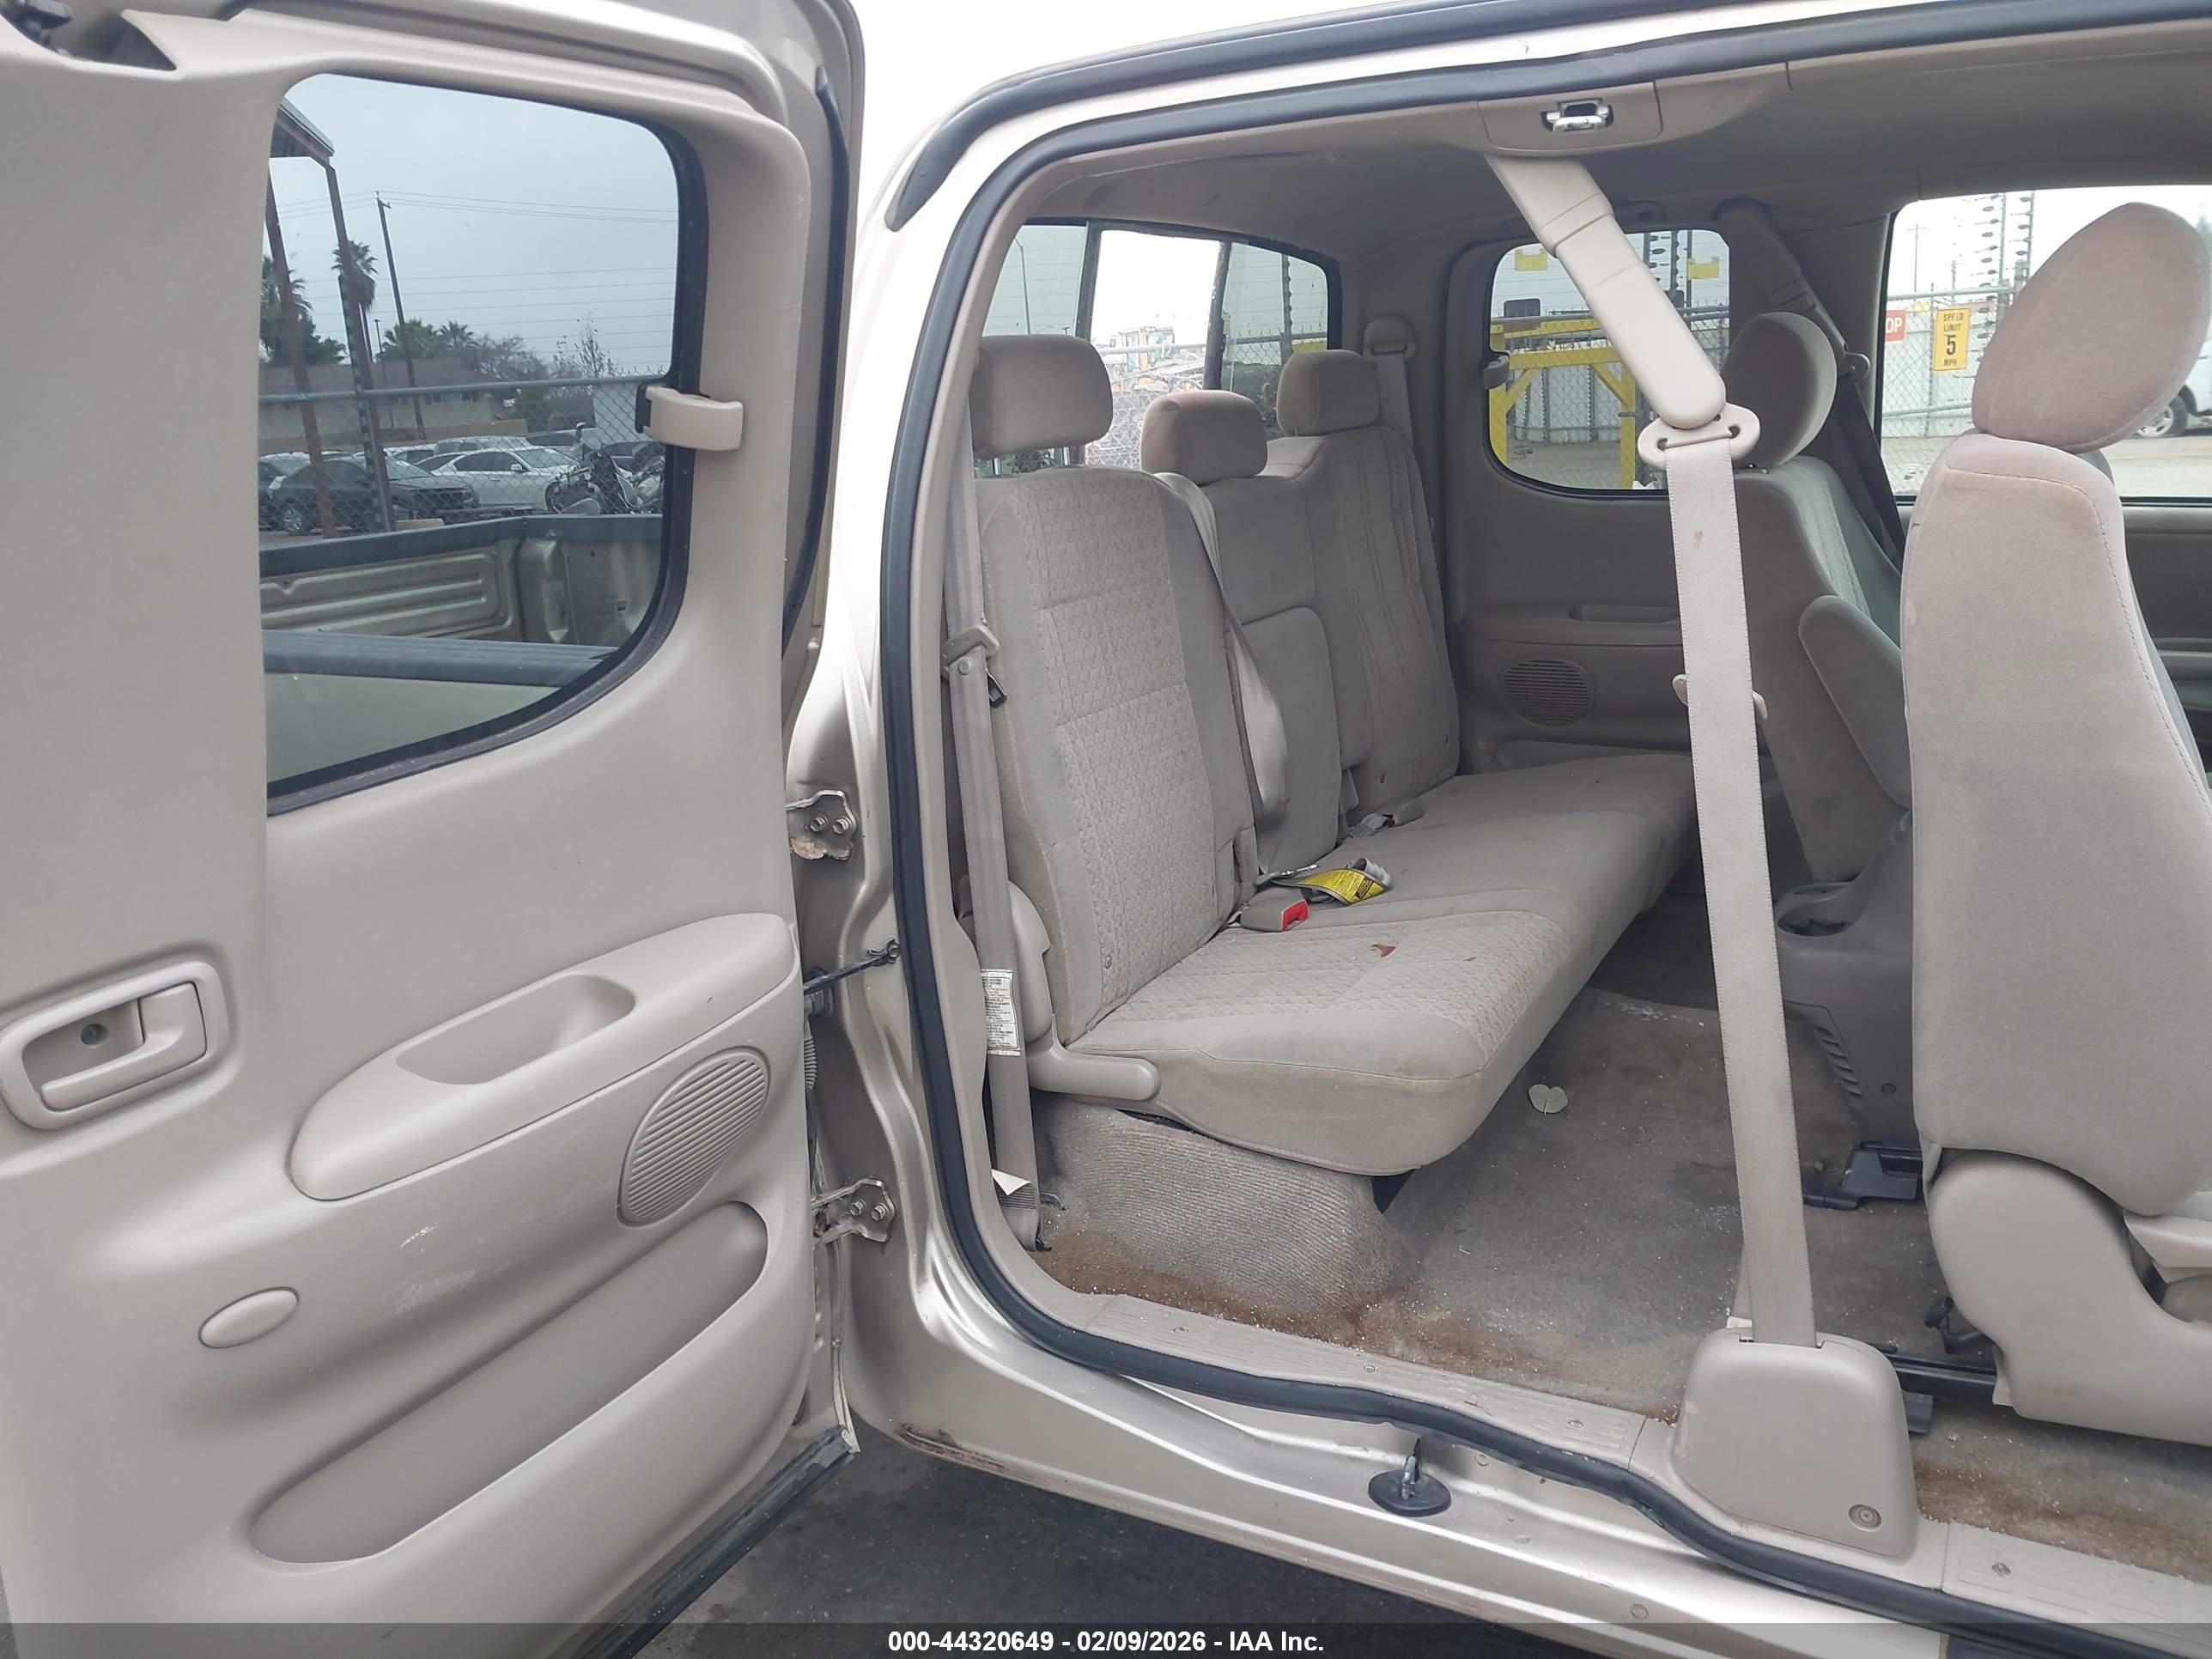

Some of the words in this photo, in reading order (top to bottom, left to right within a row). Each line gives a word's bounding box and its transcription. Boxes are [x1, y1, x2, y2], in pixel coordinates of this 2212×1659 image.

[1943, 313, 1964, 322] SPEED
[1886, 318, 1902, 333] OP
[1944, 335, 1956, 356] 5
